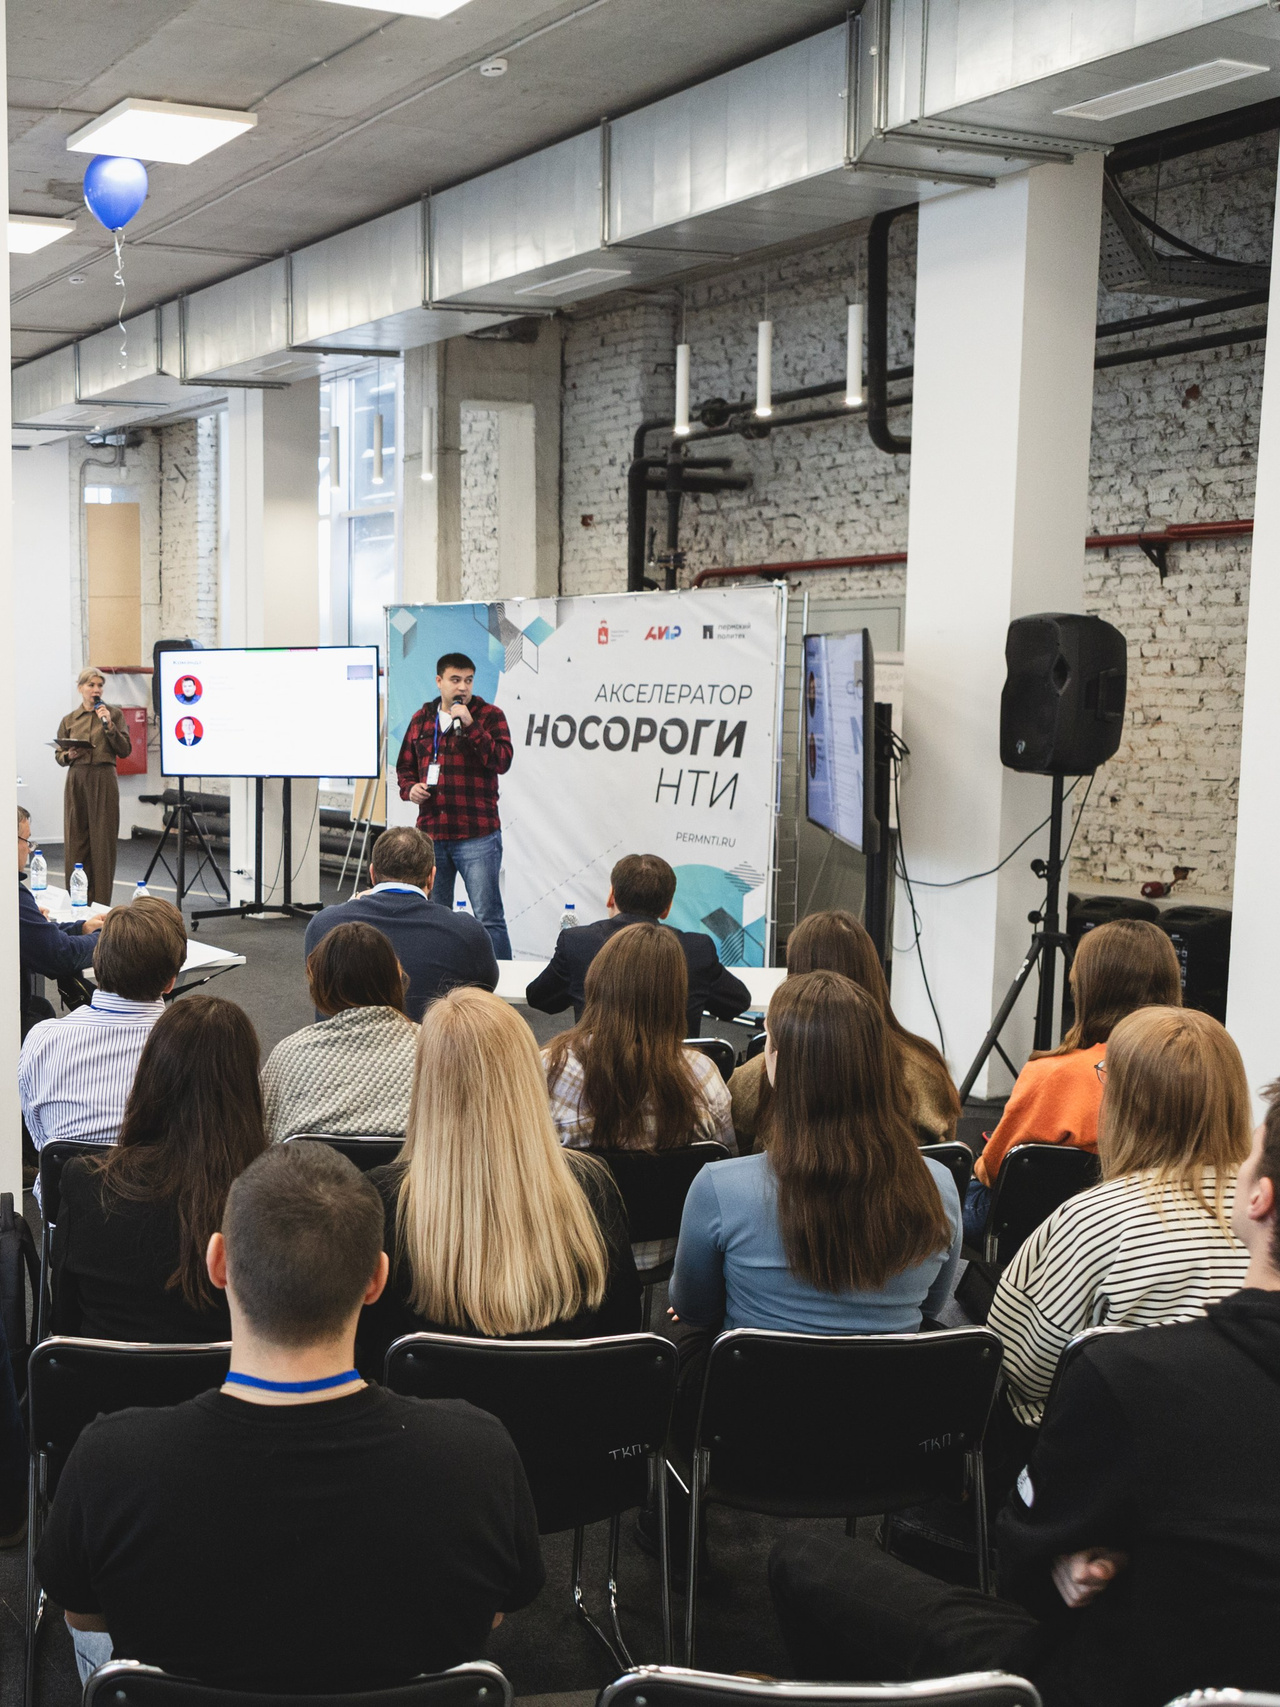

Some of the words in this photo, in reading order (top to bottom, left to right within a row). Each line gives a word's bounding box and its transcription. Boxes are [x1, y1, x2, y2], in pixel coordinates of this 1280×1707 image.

[718, 622, 751, 631] пермский
[594, 683, 753, 705] АКСЕЛЕРАТОР
[524, 713, 748, 758] НОСОРОГИ
[655, 767, 739, 810] НТИ
[675, 831, 737, 848] PERMNTI.RU
[608, 1443, 642, 1461] ТКП
[918, 1432, 952, 1453] ТКП
